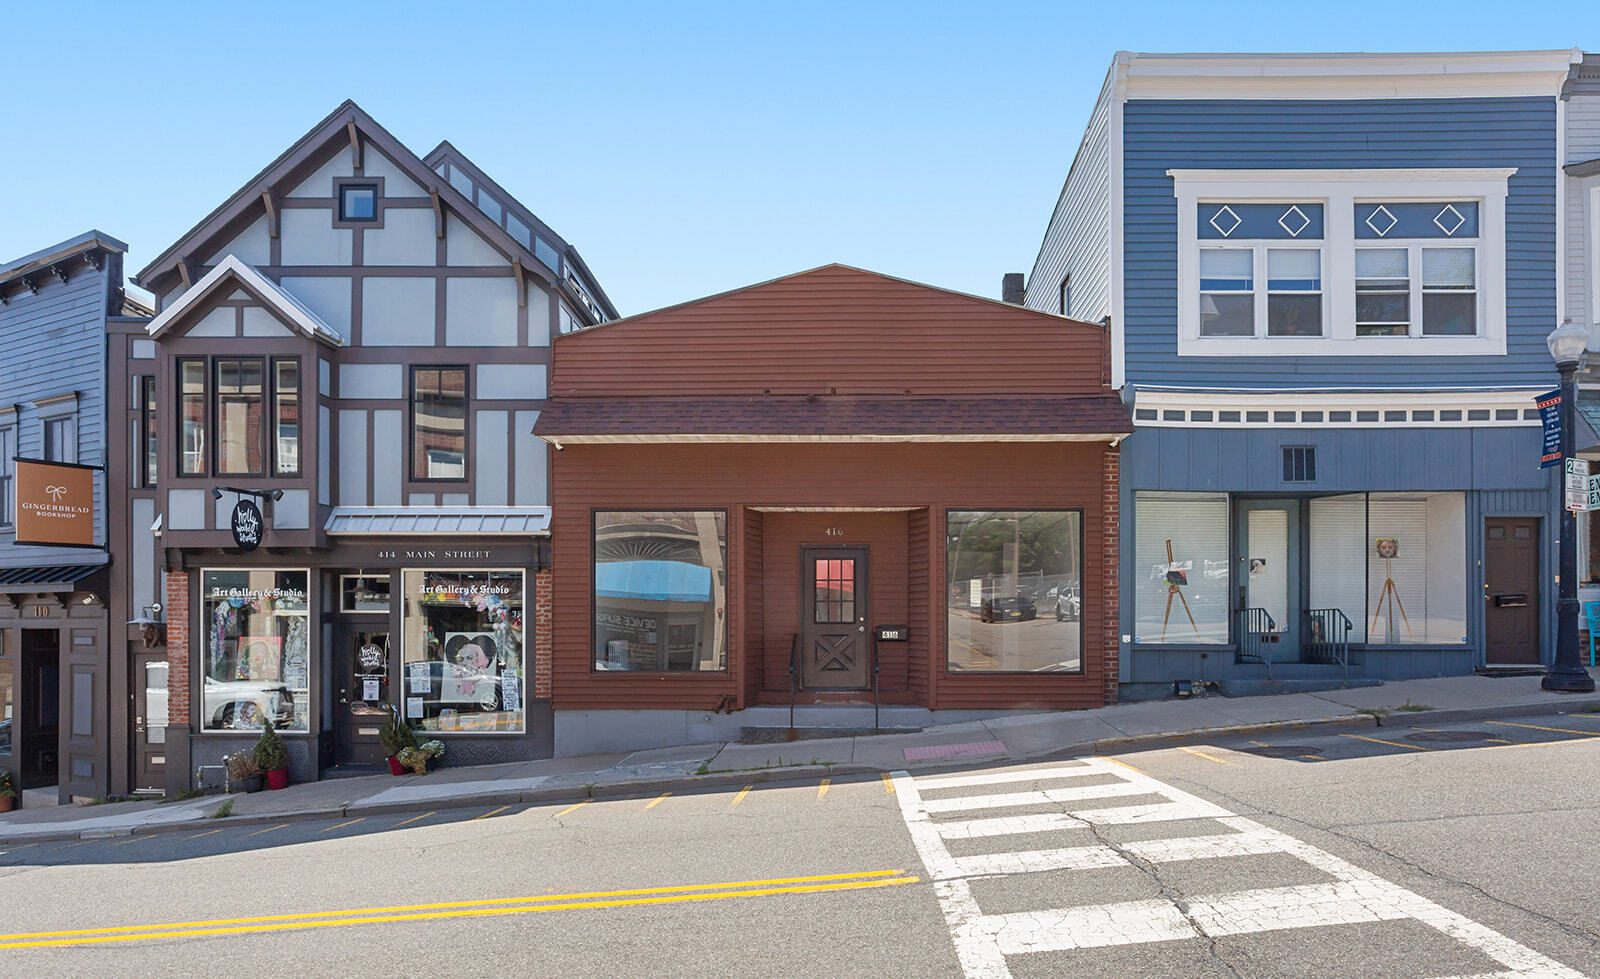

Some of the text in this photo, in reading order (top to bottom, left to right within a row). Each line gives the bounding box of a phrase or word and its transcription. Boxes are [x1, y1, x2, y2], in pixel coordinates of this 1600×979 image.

[1567, 460, 1573, 473] 2
[22, 502, 89, 513] GINGERBREAD
[825, 528, 844, 536] 416
[445, 550, 491, 558] STREET
[212, 587, 228, 597] Art
[229, 587, 264, 599] Gallery
[418, 585, 433, 594] Art
[435, 585, 469, 595] Gallery
[479, 585, 510, 595] Studio
[882, 631, 899, 639] 416
